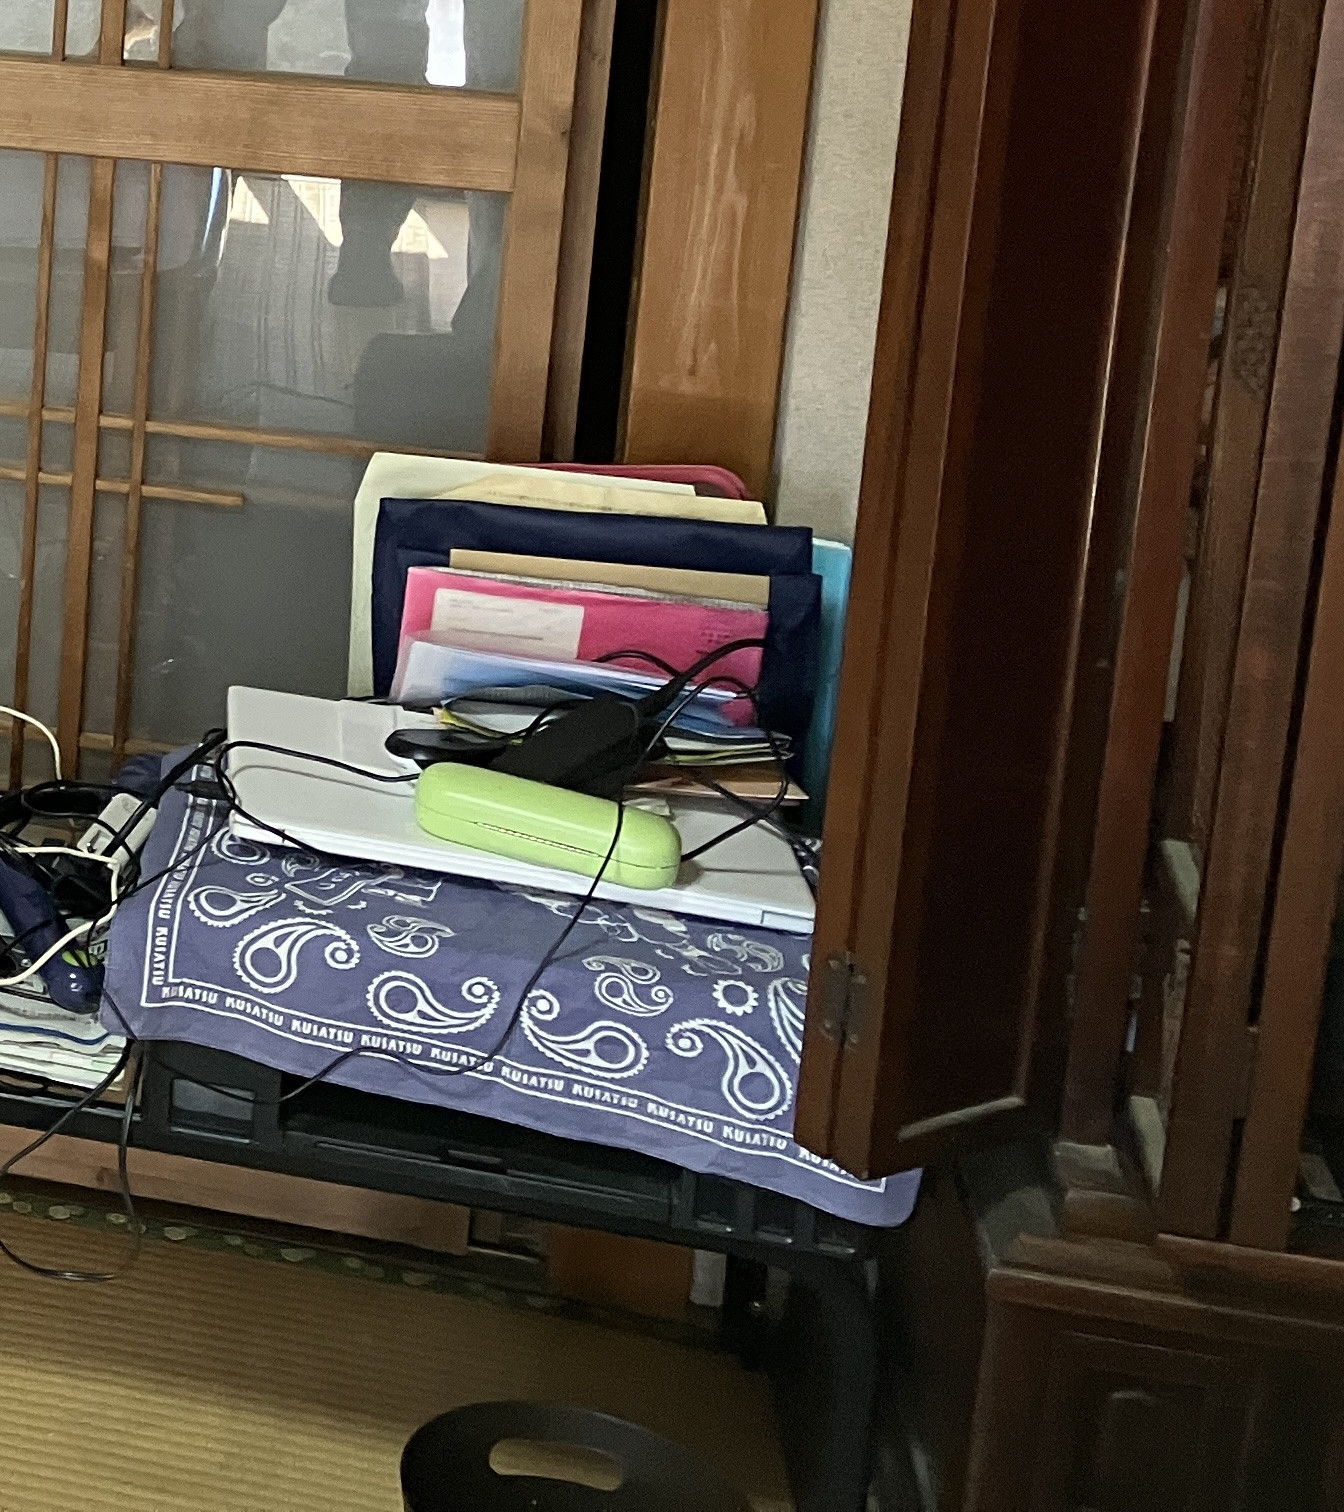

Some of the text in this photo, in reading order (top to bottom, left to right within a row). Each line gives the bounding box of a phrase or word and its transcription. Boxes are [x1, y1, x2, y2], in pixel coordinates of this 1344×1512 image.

[225, 995, 285, 1027] KUSATSU
[290, 1018, 355, 1044] KUSATSU
[359, 1034, 423, 1056] KUSATSU
[500, 1066, 565, 1092] KUSATSU
[571, 1084, 639, 1108] KUSATSU
[646, 1102, 714, 1134] KUSATSU
[722, 1124, 788, 1151] KUSATSU
